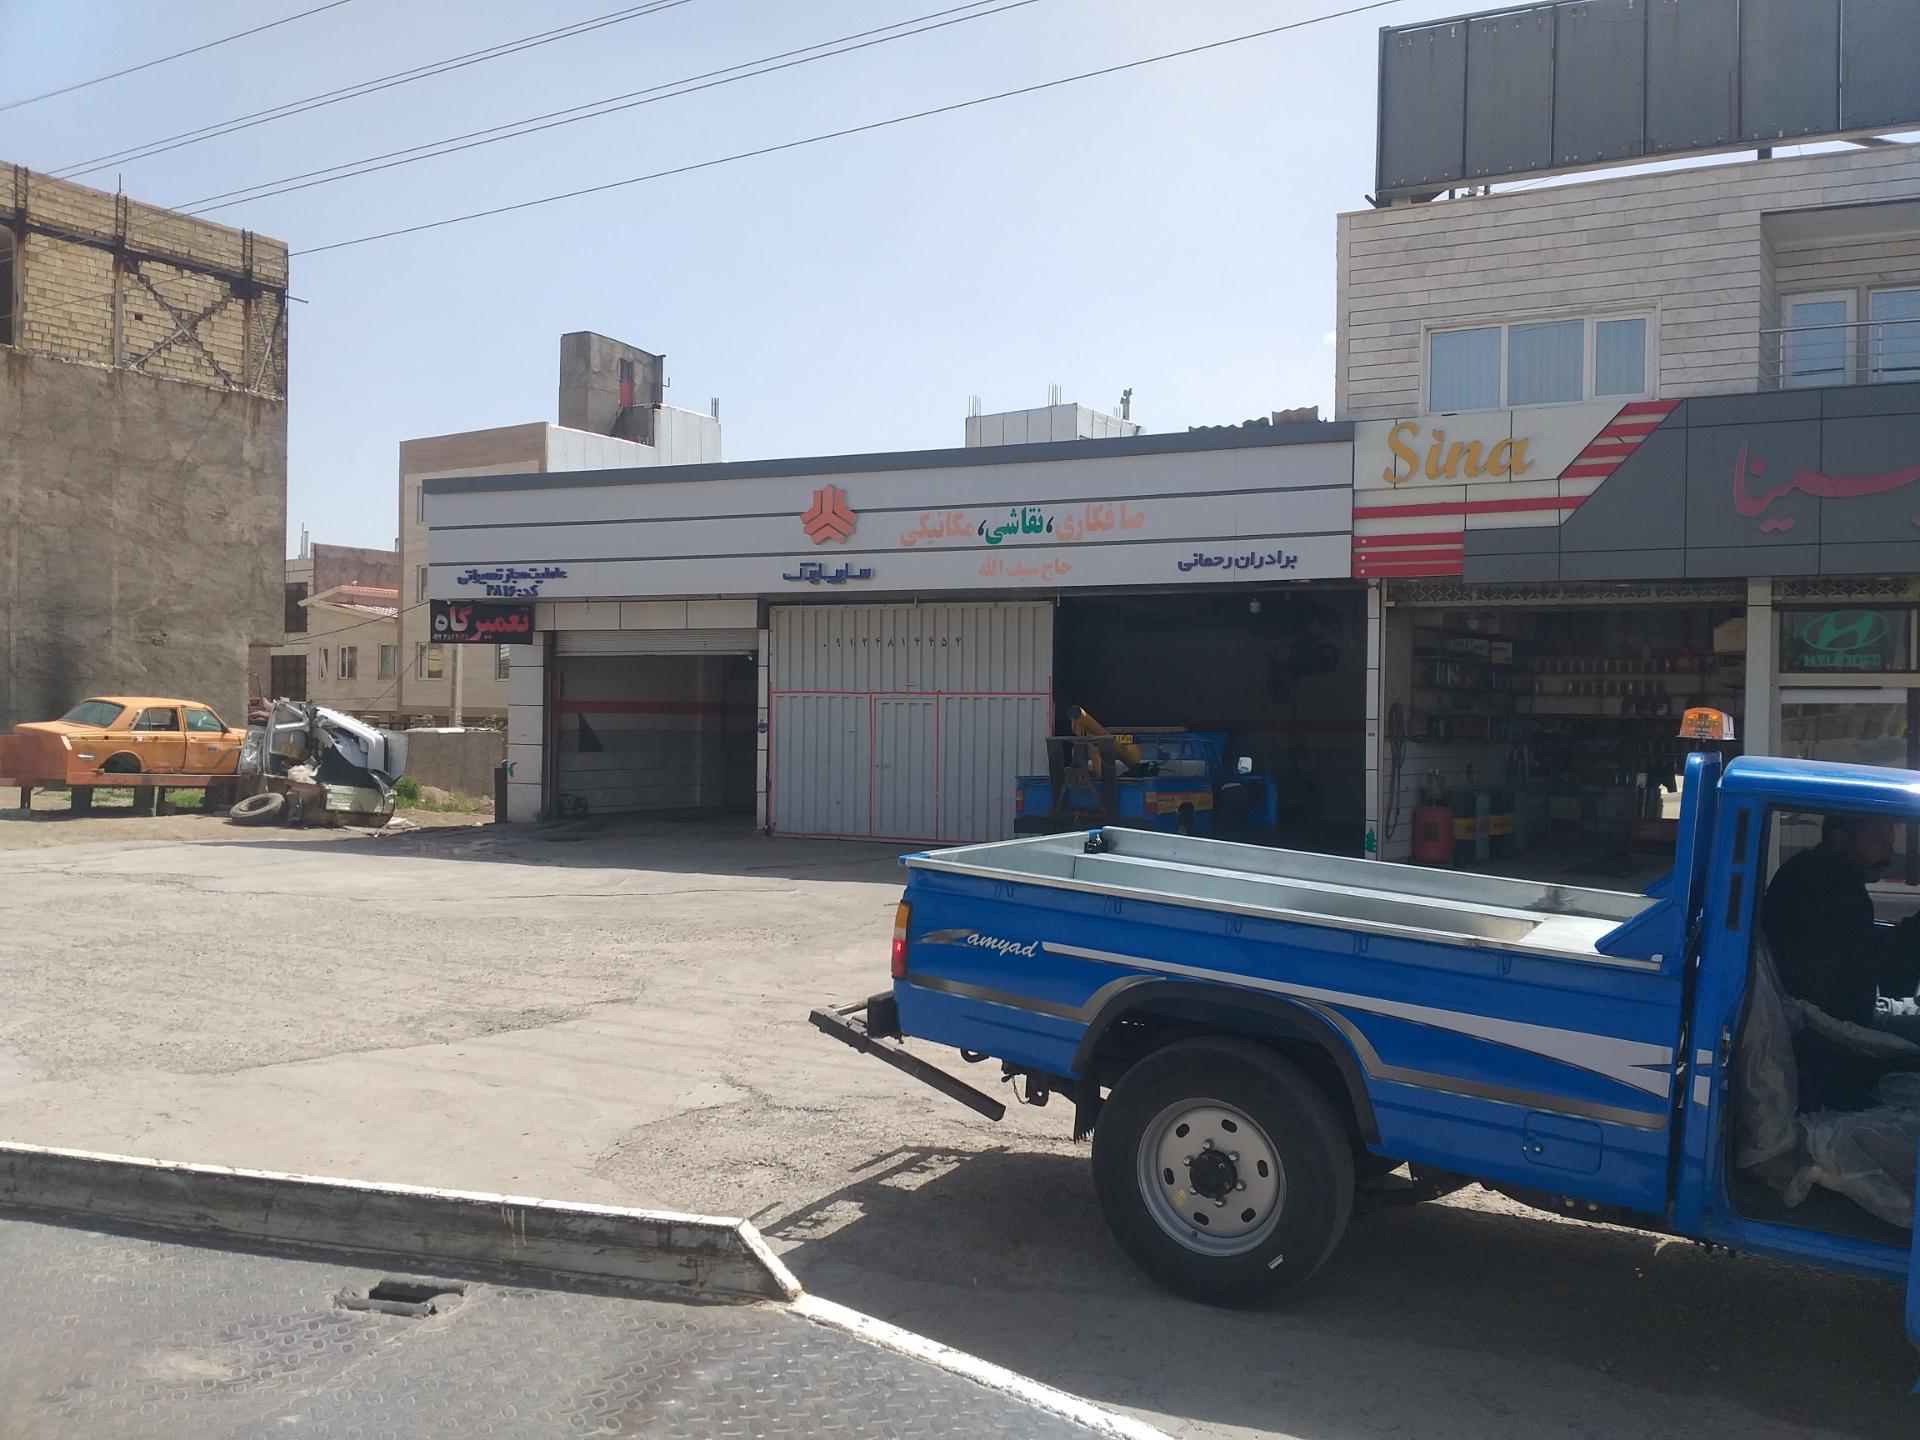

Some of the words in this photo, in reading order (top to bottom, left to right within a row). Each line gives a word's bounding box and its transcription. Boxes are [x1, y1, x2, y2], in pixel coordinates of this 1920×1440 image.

[1382, 421, 1536, 485] Sina
[900, 511, 974, 547] مکانیکی
[977, 556, 1006, 577] الله
[1040, 557, 1072, 581] حاج
[1178, 553, 1234, 571] رحمانی
[1235, 550, 1298, 569] برادران
